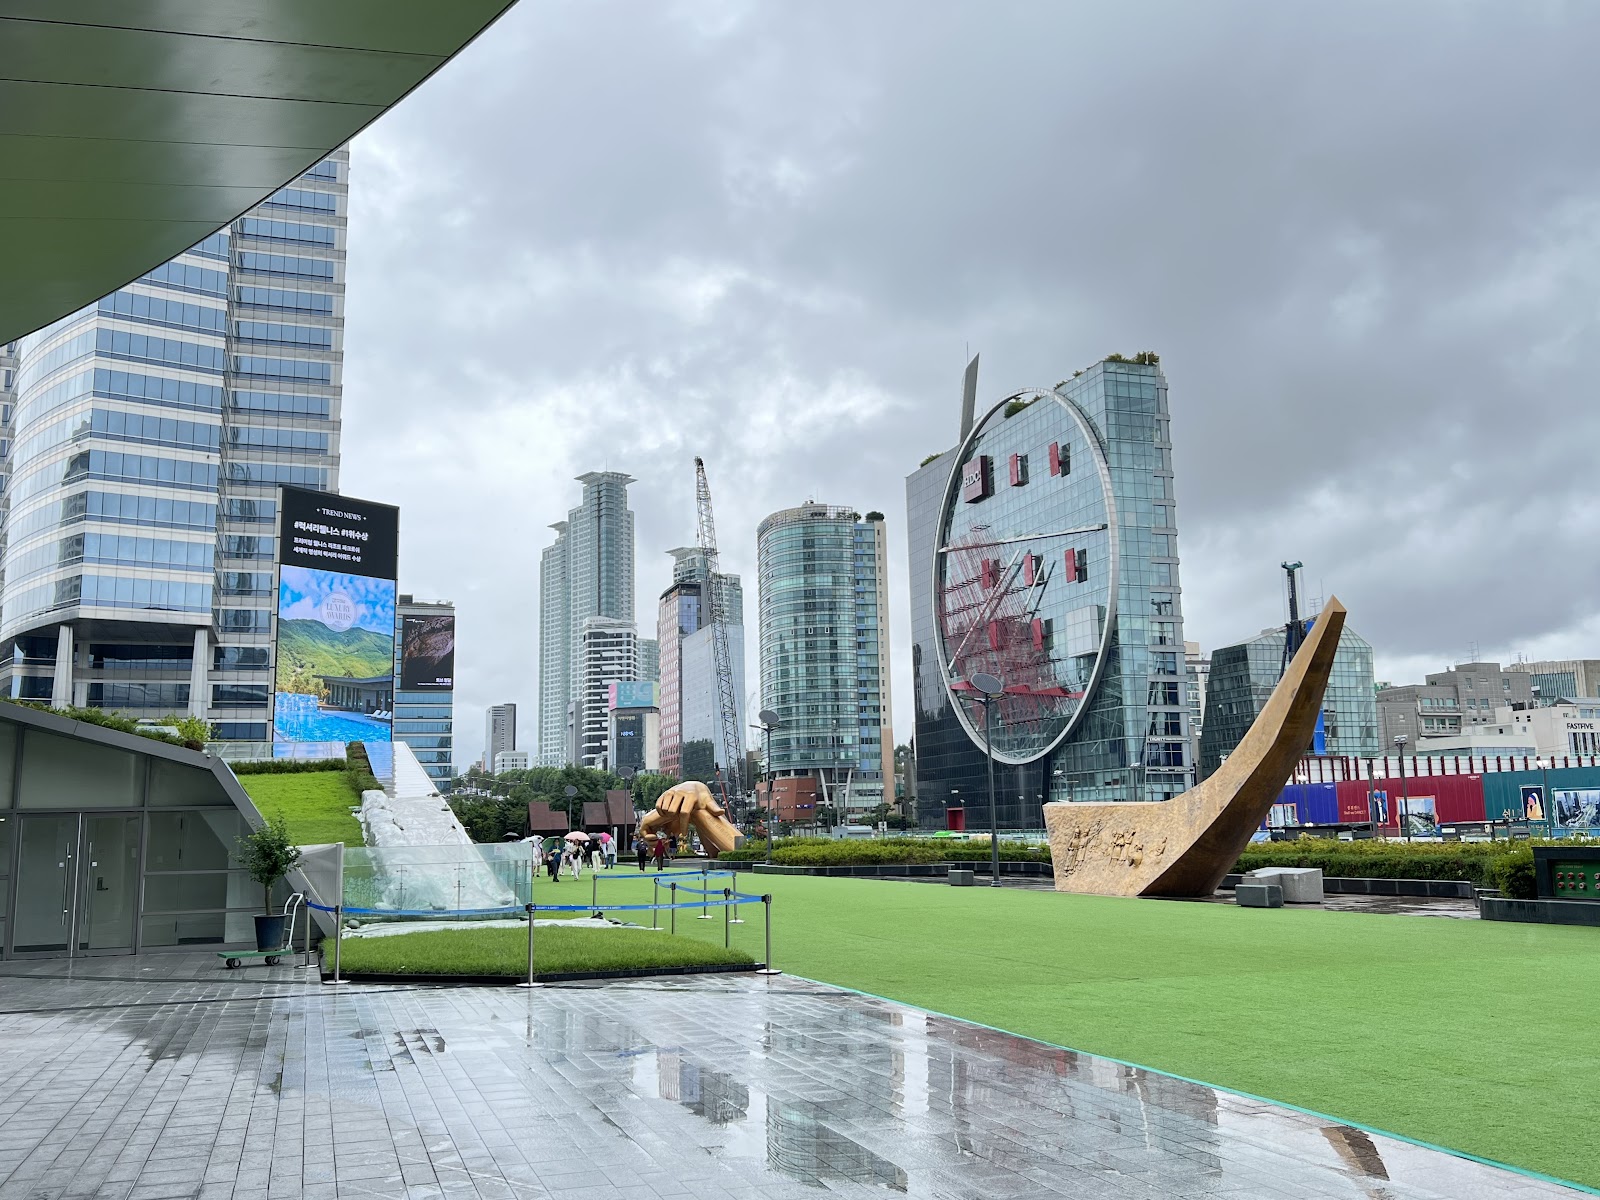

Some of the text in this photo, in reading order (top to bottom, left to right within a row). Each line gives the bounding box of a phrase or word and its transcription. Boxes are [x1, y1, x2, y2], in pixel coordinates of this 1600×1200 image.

[965, 471, 980, 488] HDC
[322, 508, 362, 520] TREND NEWS
[340, 528, 368, 541] #1위수상
[326, 603, 350, 612] LUXURY
[326, 612, 351, 620] AWARDS
